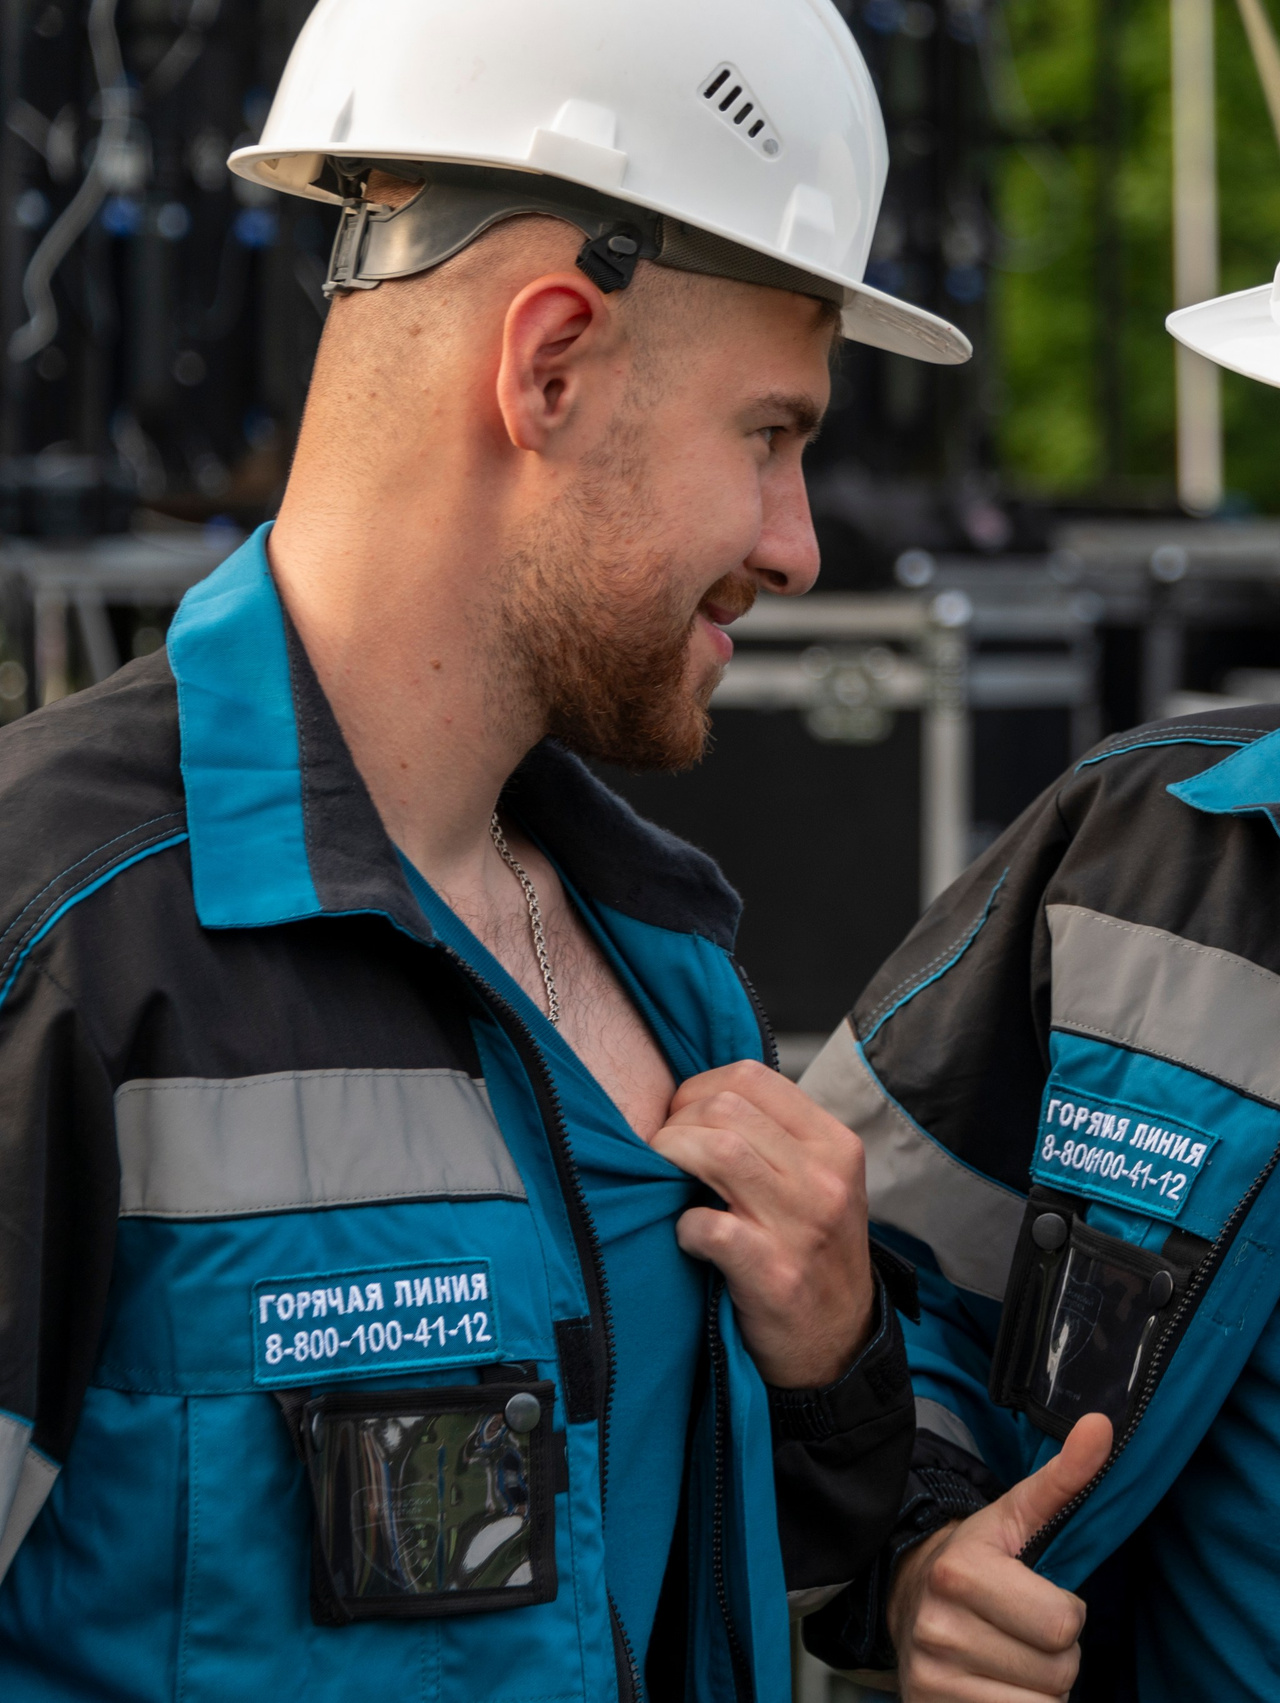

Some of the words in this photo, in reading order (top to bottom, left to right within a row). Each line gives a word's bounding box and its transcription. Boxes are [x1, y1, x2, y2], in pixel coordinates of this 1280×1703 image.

[1129, 1123, 1208, 1168] ЛИНИЯ
[259, 1282, 385, 1324] ГОРЯЧАЯ
[394, 1272, 489, 1307] ЛИНИЯ
[265, 1311, 493, 1365] 8-800-100-41-12
